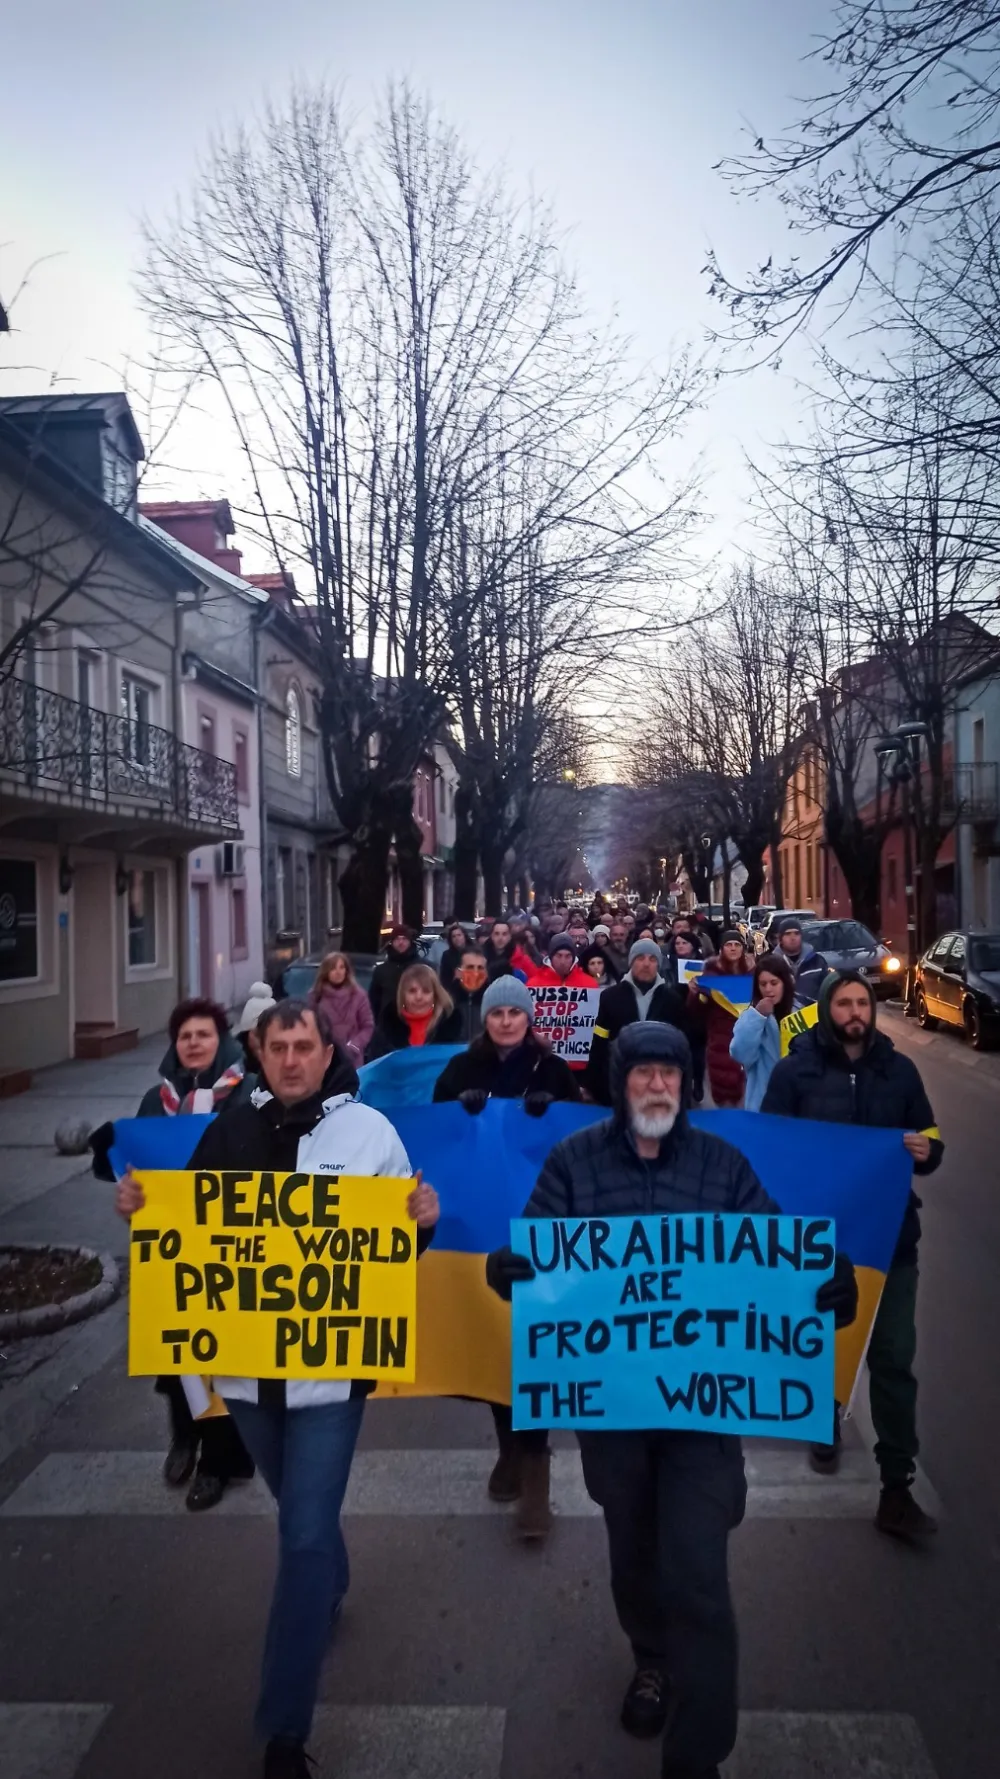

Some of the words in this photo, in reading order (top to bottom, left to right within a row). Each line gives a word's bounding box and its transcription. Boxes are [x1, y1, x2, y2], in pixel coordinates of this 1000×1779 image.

[534, 1001, 578, 1016] STOP
[552, 1041, 590, 1054] EPINGS
[194, 1172, 340, 1228] PEACE
[132, 1229, 182, 1262] TO
[210, 1235, 266, 1262] THE
[293, 1227, 411, 1263] WORLD
[175, 1262, 360, 1312] PRISON
[619, 1270, 682, 1305] ARE
[162, 1329, 218, 1364] TO
[275, 1316, 408, 1368] PUTIN
[518, 1381, 605, 1418] THE
[655, 1372, 814, 1421] WORLD
